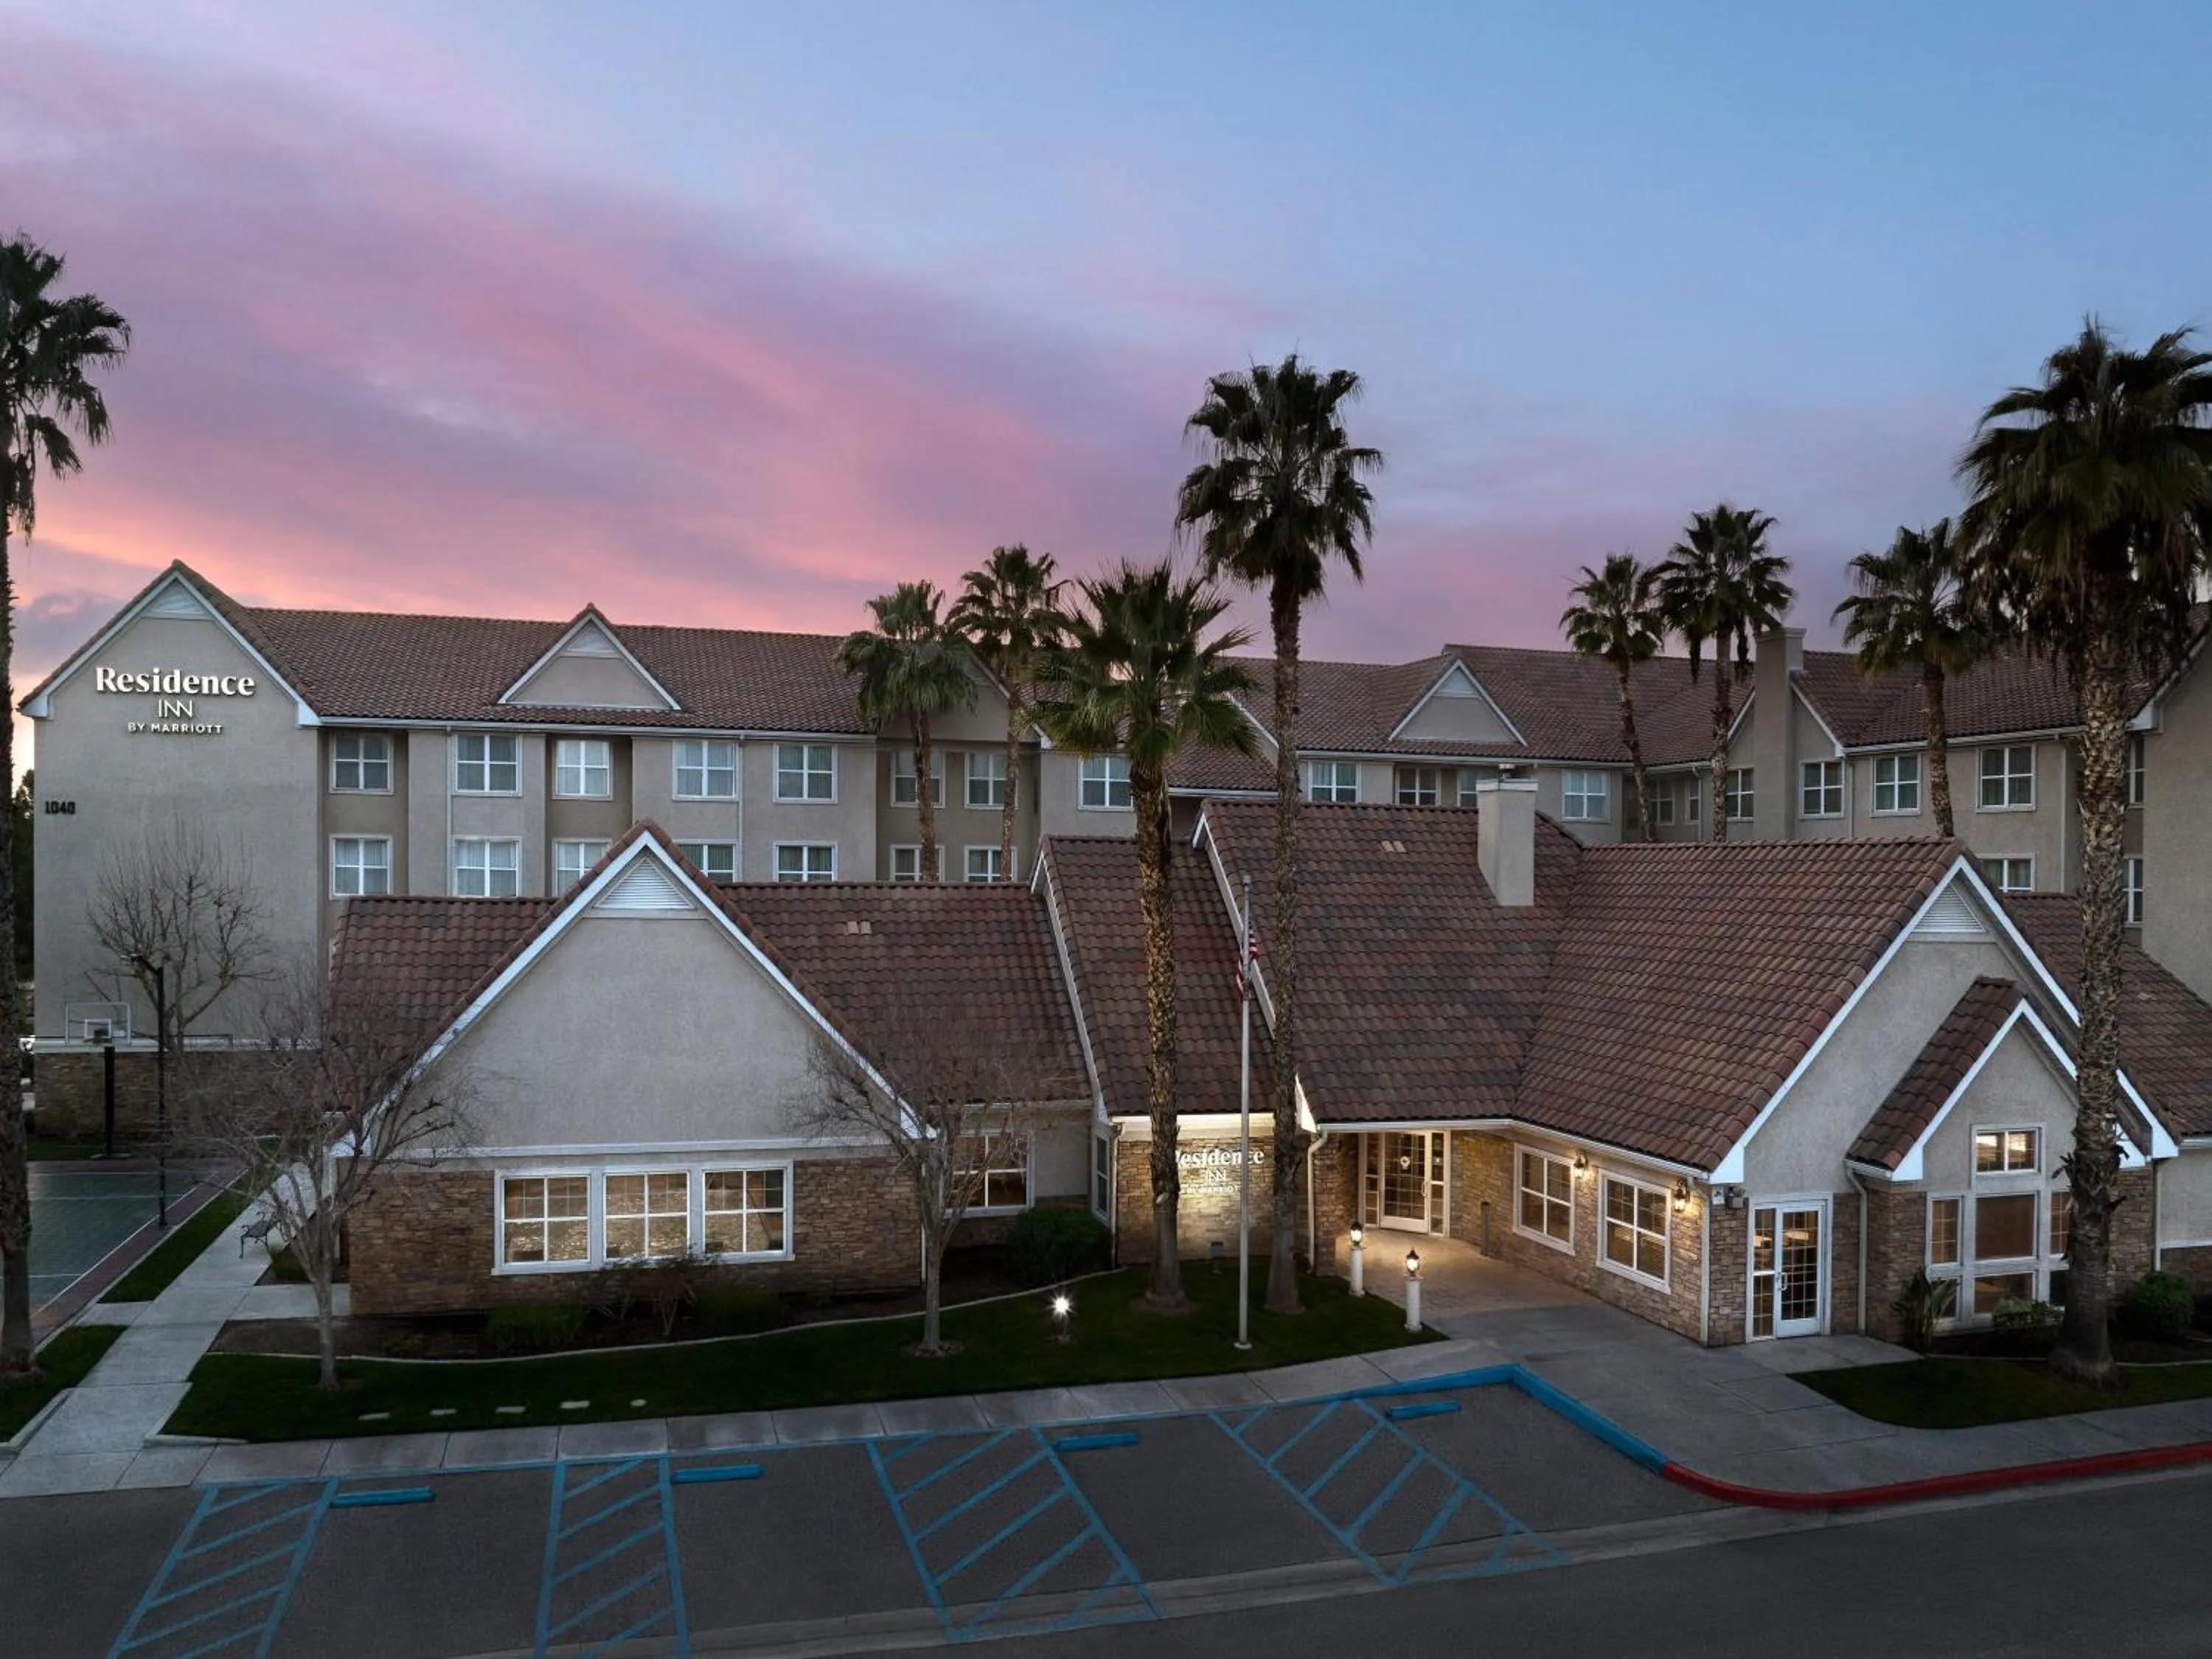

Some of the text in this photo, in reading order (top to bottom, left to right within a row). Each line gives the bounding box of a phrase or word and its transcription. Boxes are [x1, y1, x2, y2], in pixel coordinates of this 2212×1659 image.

[95, 667, 256, 696] Residence
[158, 699, 194, 718] INN
[128, 722, 223, 734] BY MARRIOTT
[44, 800, 76, 815] 1040
